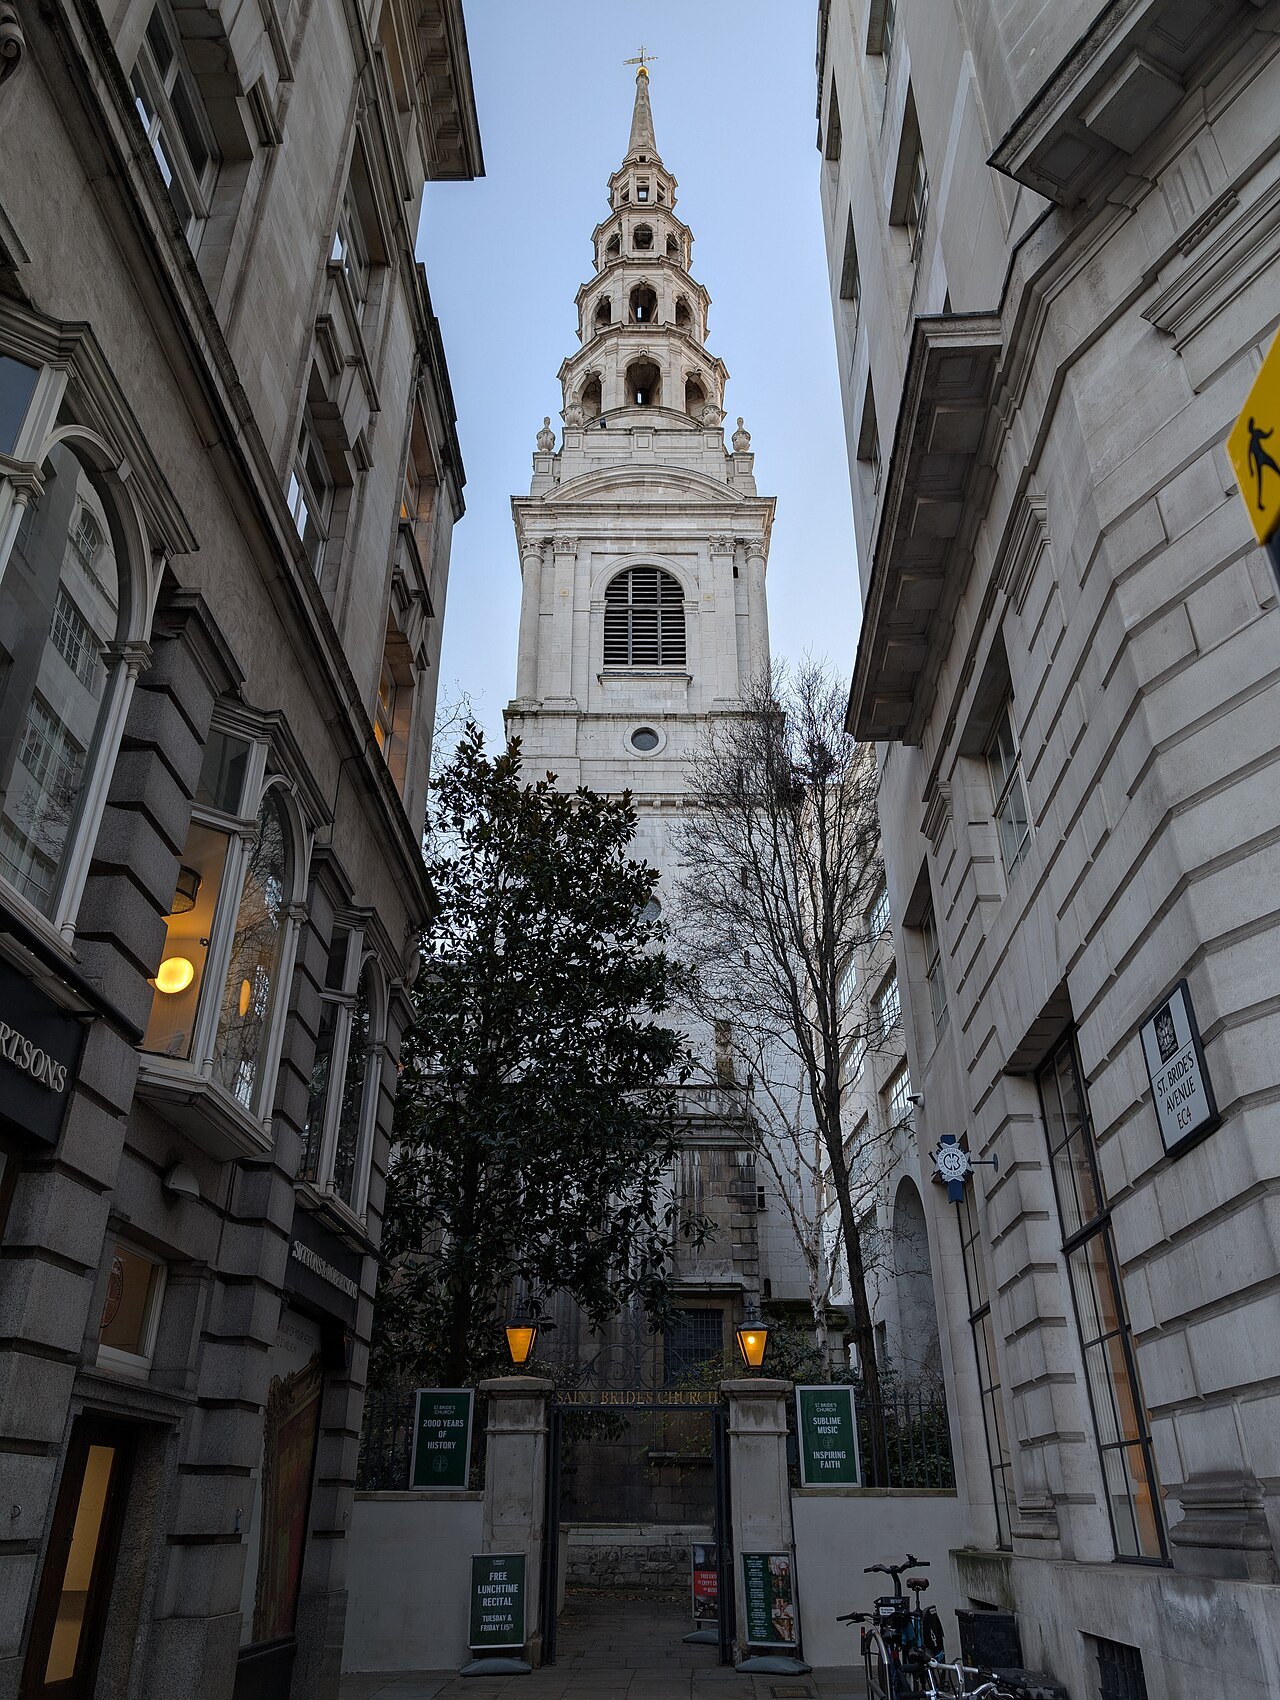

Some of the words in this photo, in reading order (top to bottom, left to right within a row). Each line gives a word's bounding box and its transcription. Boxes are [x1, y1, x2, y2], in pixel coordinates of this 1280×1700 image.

[1157, 1076, 1168, 1097] ST.
[1167, 1051, 1194, 1088] BRIDE'S
[1167, 1075, 1196, 1115] AVENUE
[1177, 1106, 1192, 1130] EC4
[557, 1390, 597, 1404] SAINT
[600, 1390, 653, 1404] BRIDES
[658, 1390, 719, 1404] CHURCH
[813, 1417, 842, 1425] SUBLIME
[817, 1426, 838, 1434] MUSIC
[427, 1442, 457, 1450] HISTORY
[814, 1451, 846, 1459] INSPIRING
[820, 1460, 840, 1468] FAITH
[490, 1572, 508, 1580] FREE
[478, 1584, 518, 1594] LUNCHTIME
[482, 1597, 512, 1606] RECITAL
